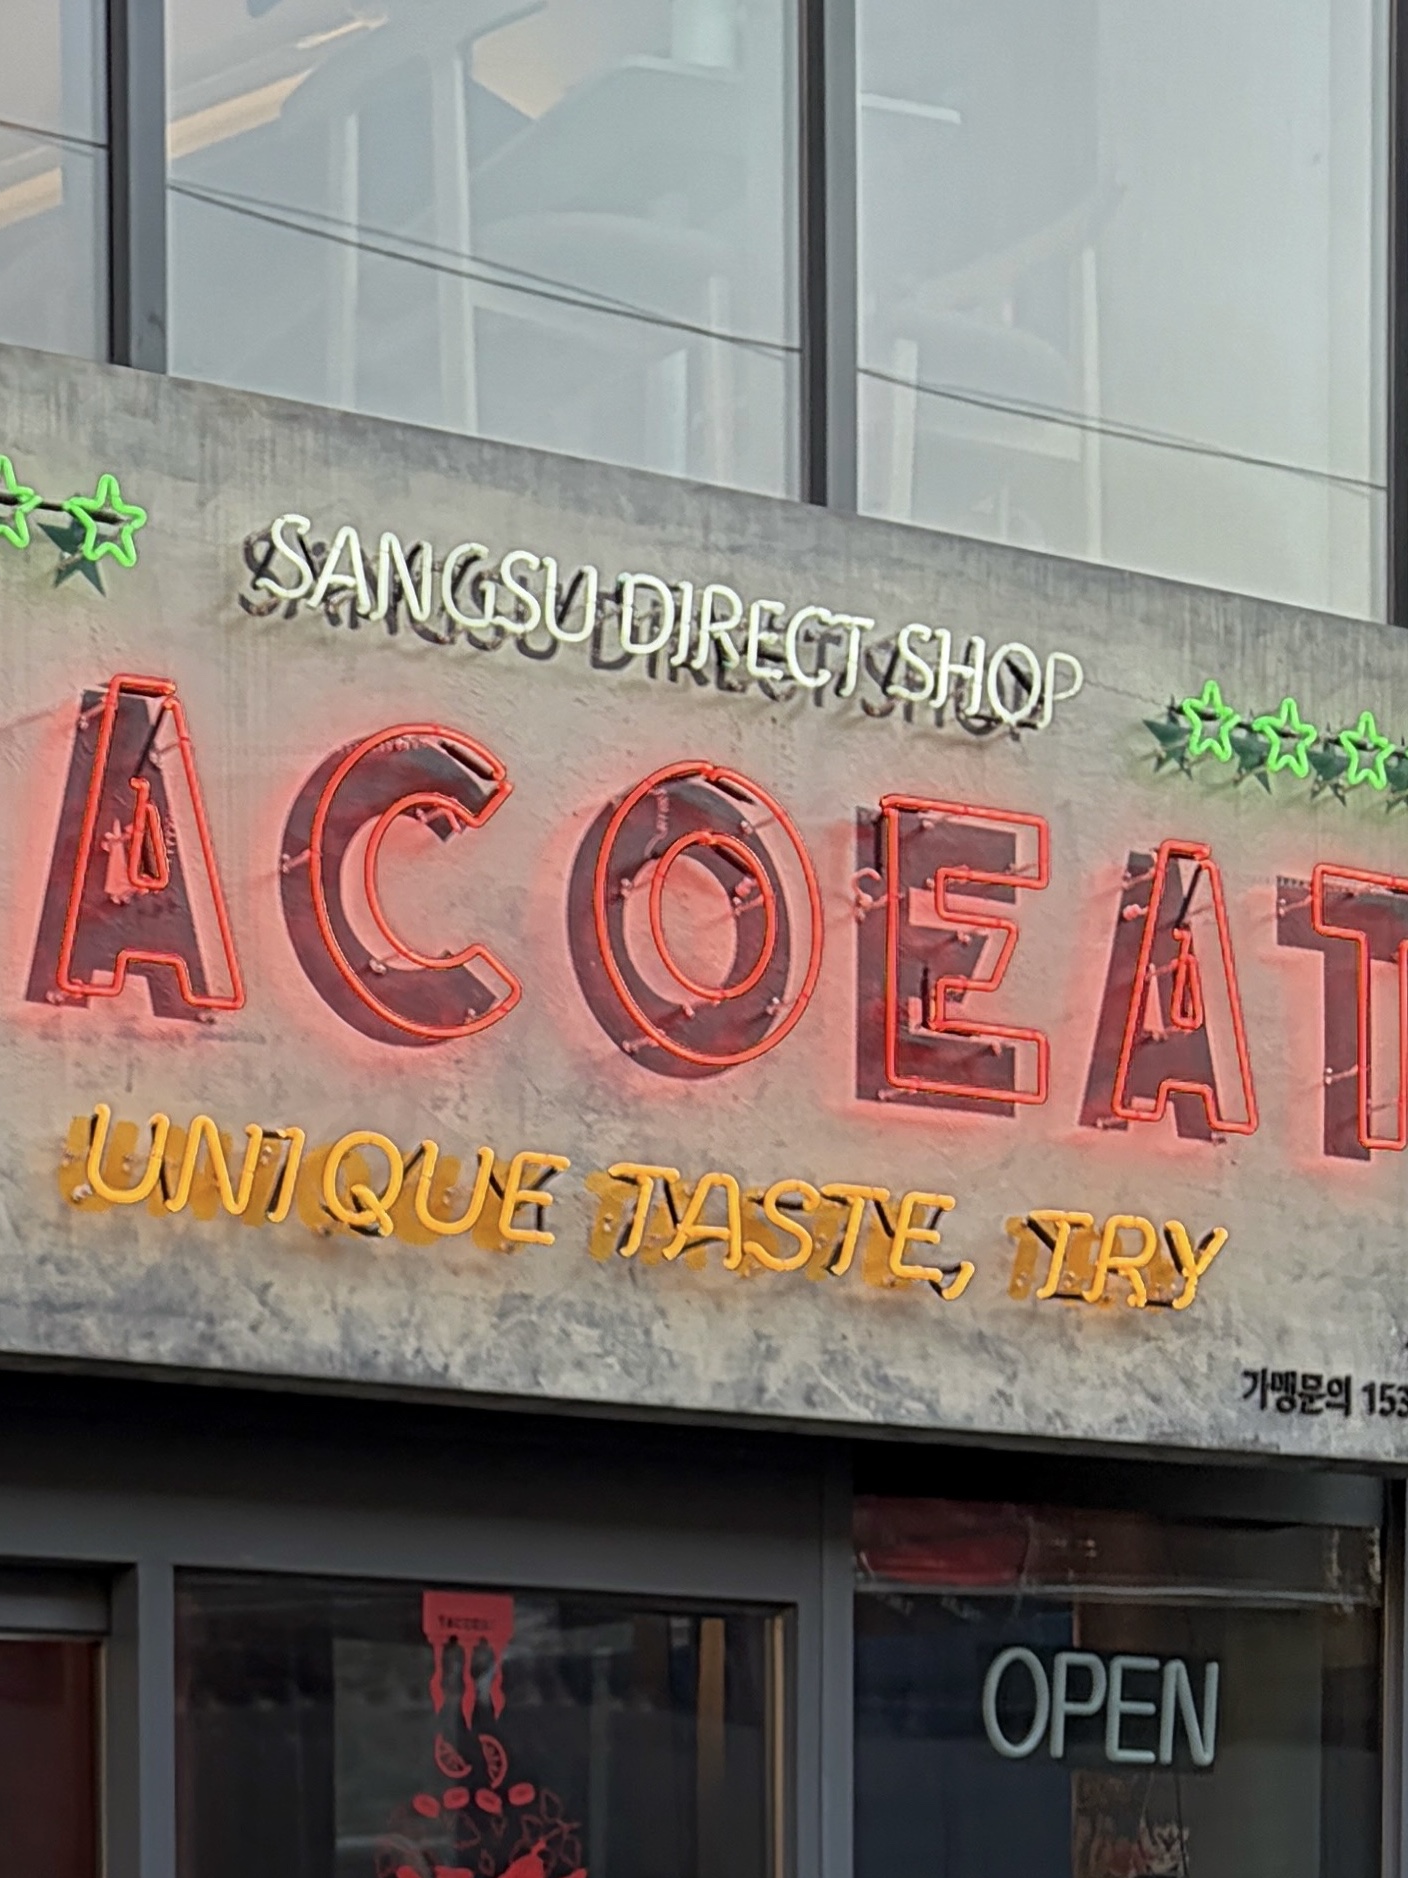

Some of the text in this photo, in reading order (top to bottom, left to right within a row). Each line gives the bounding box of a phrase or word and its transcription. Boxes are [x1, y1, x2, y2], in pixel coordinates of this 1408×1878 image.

[250, 512, 1085, 731] SANGSU DIRECT SHOP
[84, 1102, 1231, 1312] UNIQUE TASTE, TRY
[1241, 1367, 1352, 1418] 가맹문의
[984, 1646, 1221, 1768] OPEN
